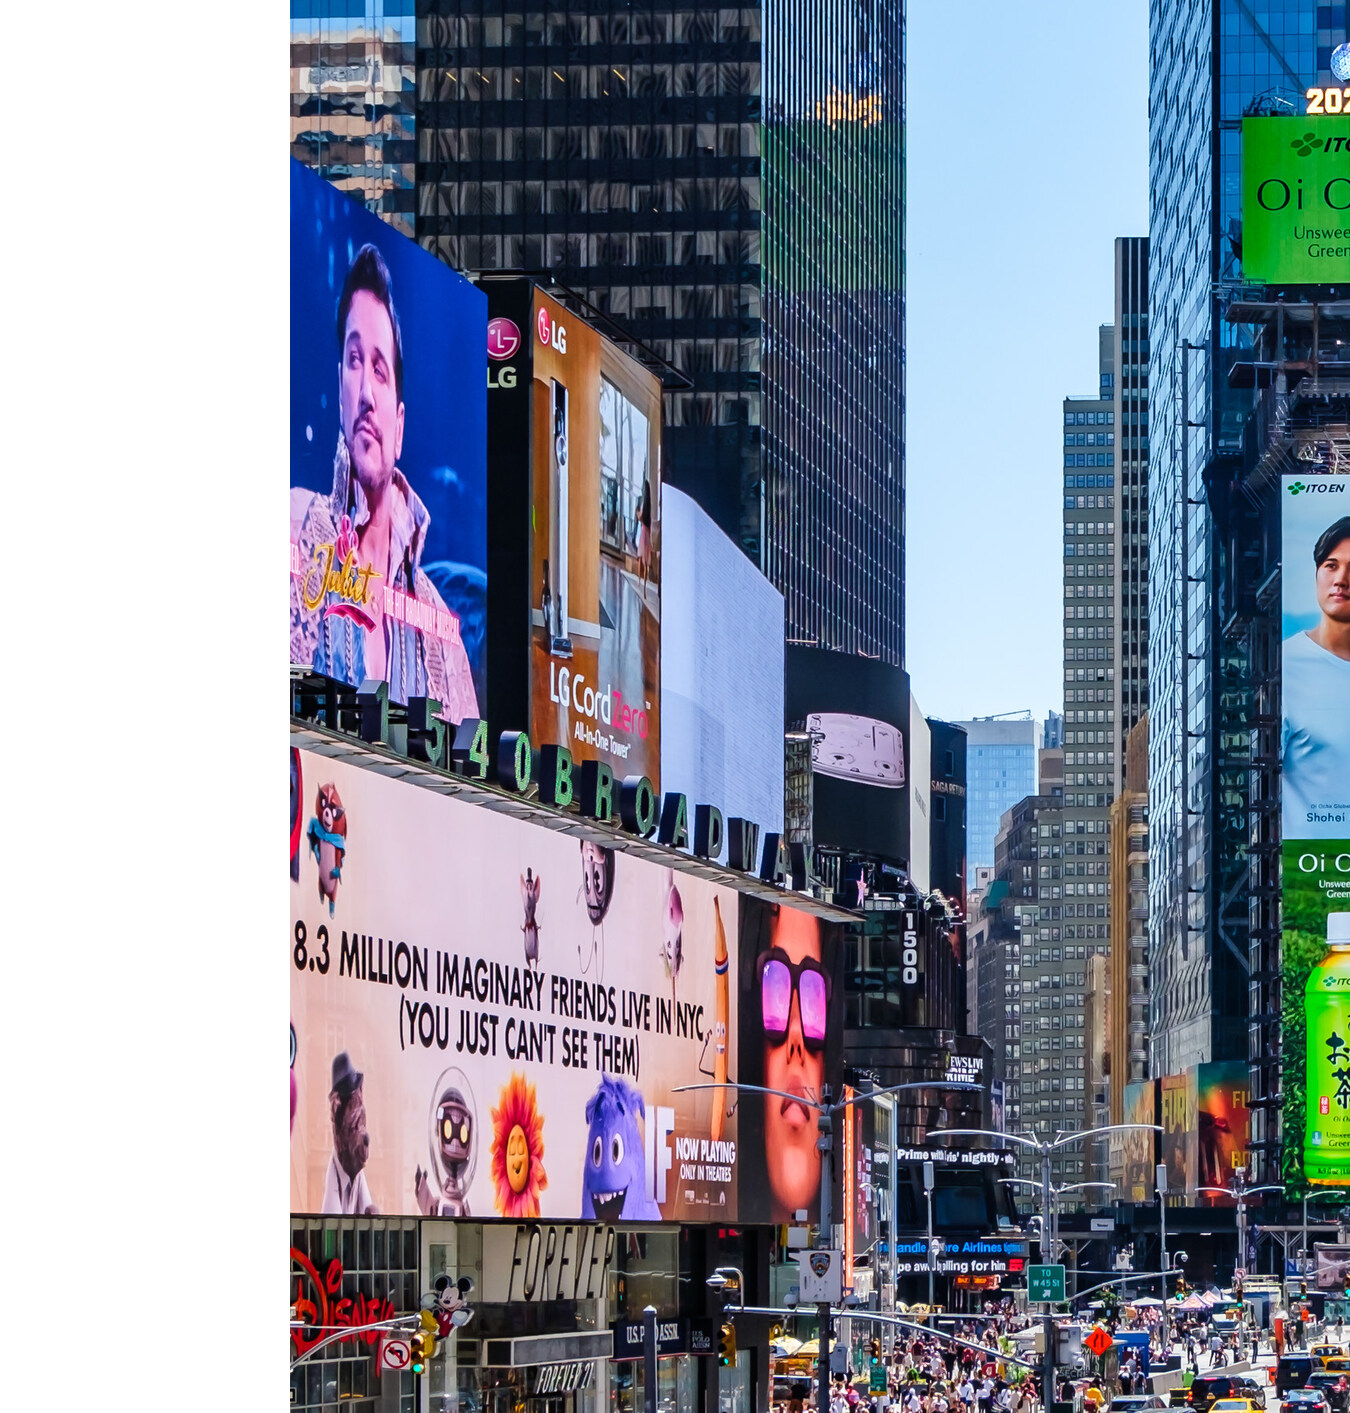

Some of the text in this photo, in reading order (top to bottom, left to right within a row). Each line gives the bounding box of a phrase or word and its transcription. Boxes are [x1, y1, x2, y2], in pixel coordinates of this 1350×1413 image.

[1257, 178, 1303, 211] Oi
[551, 320, 567, 355] LG
[487, 366, 517, 389] LG
[1306, 484, 1345, 493] ITO EN
[303, 543, 384, 611] Juliet
[550, 661, 570, 707] LG
[357, 680, 532, 793] 1540
[609, 734, 628, 759] Tower
[540, 744, 814, 892] BROADWAY
[1306, 812, 1345, 822] Shohei
[1298, 853, 1325, 872] Oi
[1326, 890, 1350, 898] Green
[903, 912, 917, 984] 1500
[293, 919, 330, 975] 8.3
[339, 931, 428, 991] MILLION
[436, 950, 544, 1012] IMAGINARY
[550, 973, 616, 1026] FRIENDS
[622, 989, 651, 1031] LIVE
[656, 995, 671, 1036] IN
[400, 994, 640, 1082] (YOU JUST CAN'T SEE THEM)
[645, 1106, 674, 1203] IF
[675, 1136, 736, 1165] NOW PLAYING
[897, 1149, 929, 1160] Prime
[961, 1152, 1000, 1165] nightly
[680, 1163, 732, 1182] ONLY IN THEATRES
[962, 1241, 1002, 1253] Airlines
[508, 1225, 615, 1302] FOREVER
[971, 1260, 989, 1272] for
[1041, 1269, 1052, 1277] TO
[1032, 1279, 1039, 1287] W
[1040, 1279, 1051, 1287] 45
[536, 1362, 594, 1394] FOREVER 21
